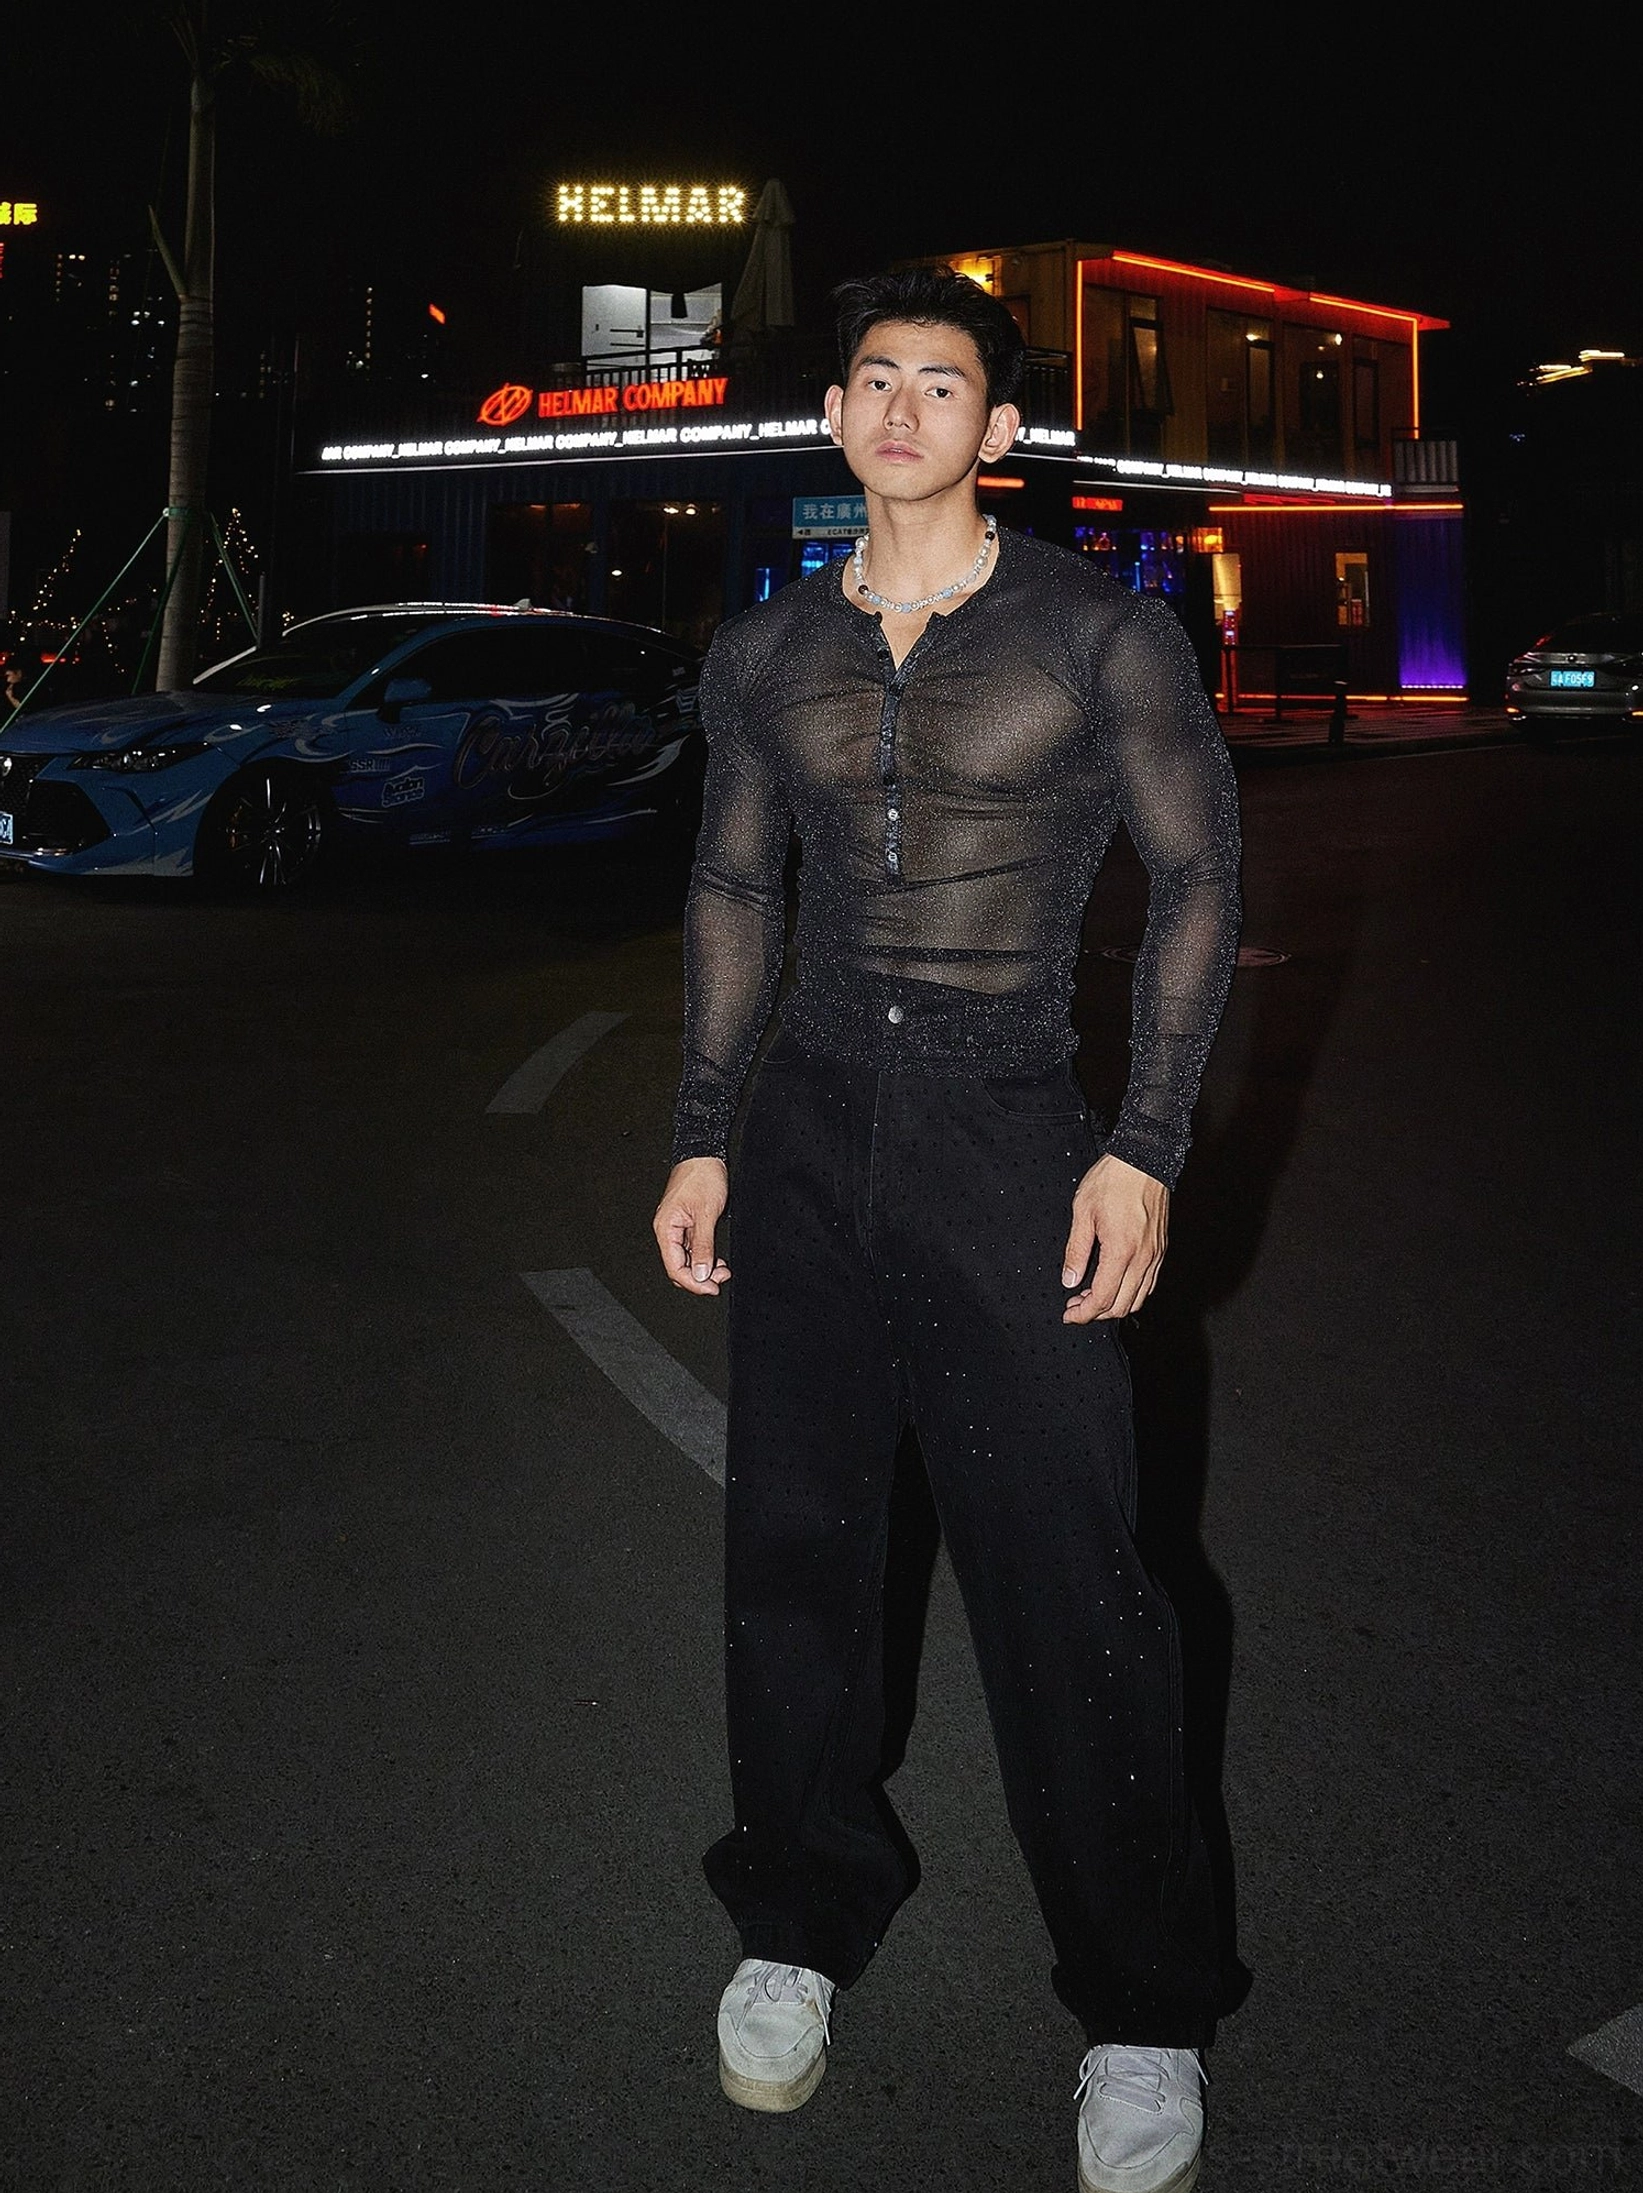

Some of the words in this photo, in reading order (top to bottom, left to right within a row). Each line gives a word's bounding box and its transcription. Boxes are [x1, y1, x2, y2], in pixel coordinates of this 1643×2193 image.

[558, 183, 745, 223] HELMAR
[538, 387, 618, 418] HELMAR
[624, 377, 728, 411] COMPANY
